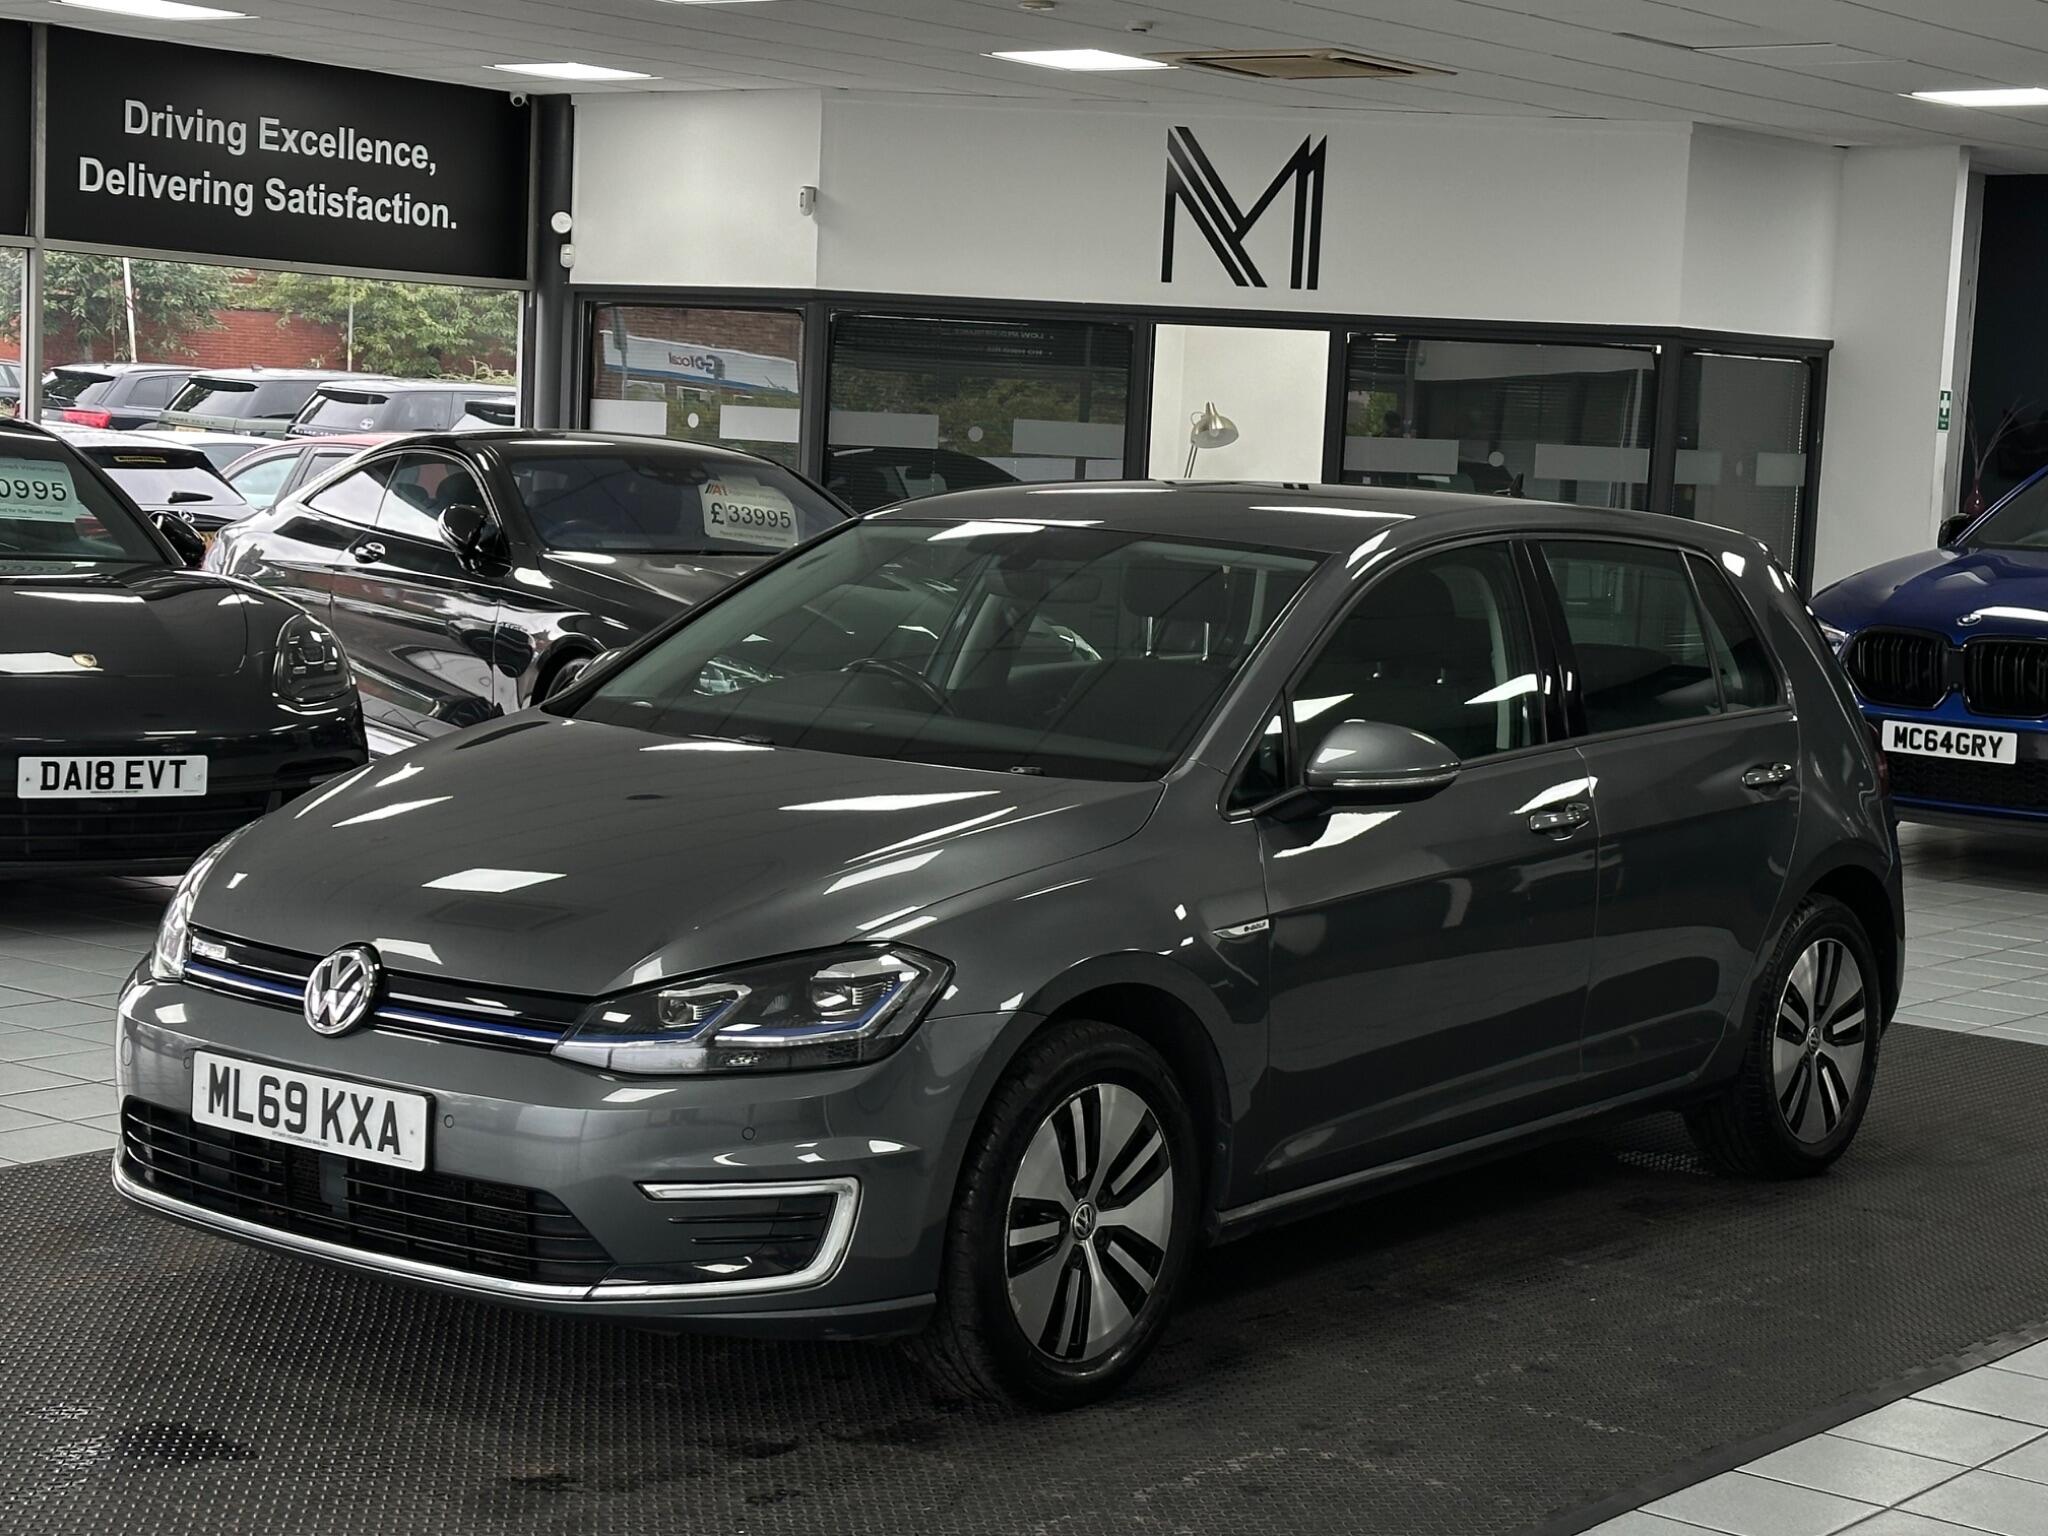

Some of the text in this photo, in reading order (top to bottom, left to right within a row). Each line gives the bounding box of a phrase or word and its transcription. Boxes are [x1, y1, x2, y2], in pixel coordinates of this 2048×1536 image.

[124, 99, 437, 177] Driving Excellence,
[78, 156, 458, 230] Delivering Satisfaction.
[40, 759, 187, 791] DA18 EVT
[1893, 726, 2003, 759] MC64GRY
[207, 1063, 401, 1156] ML69 KXA
